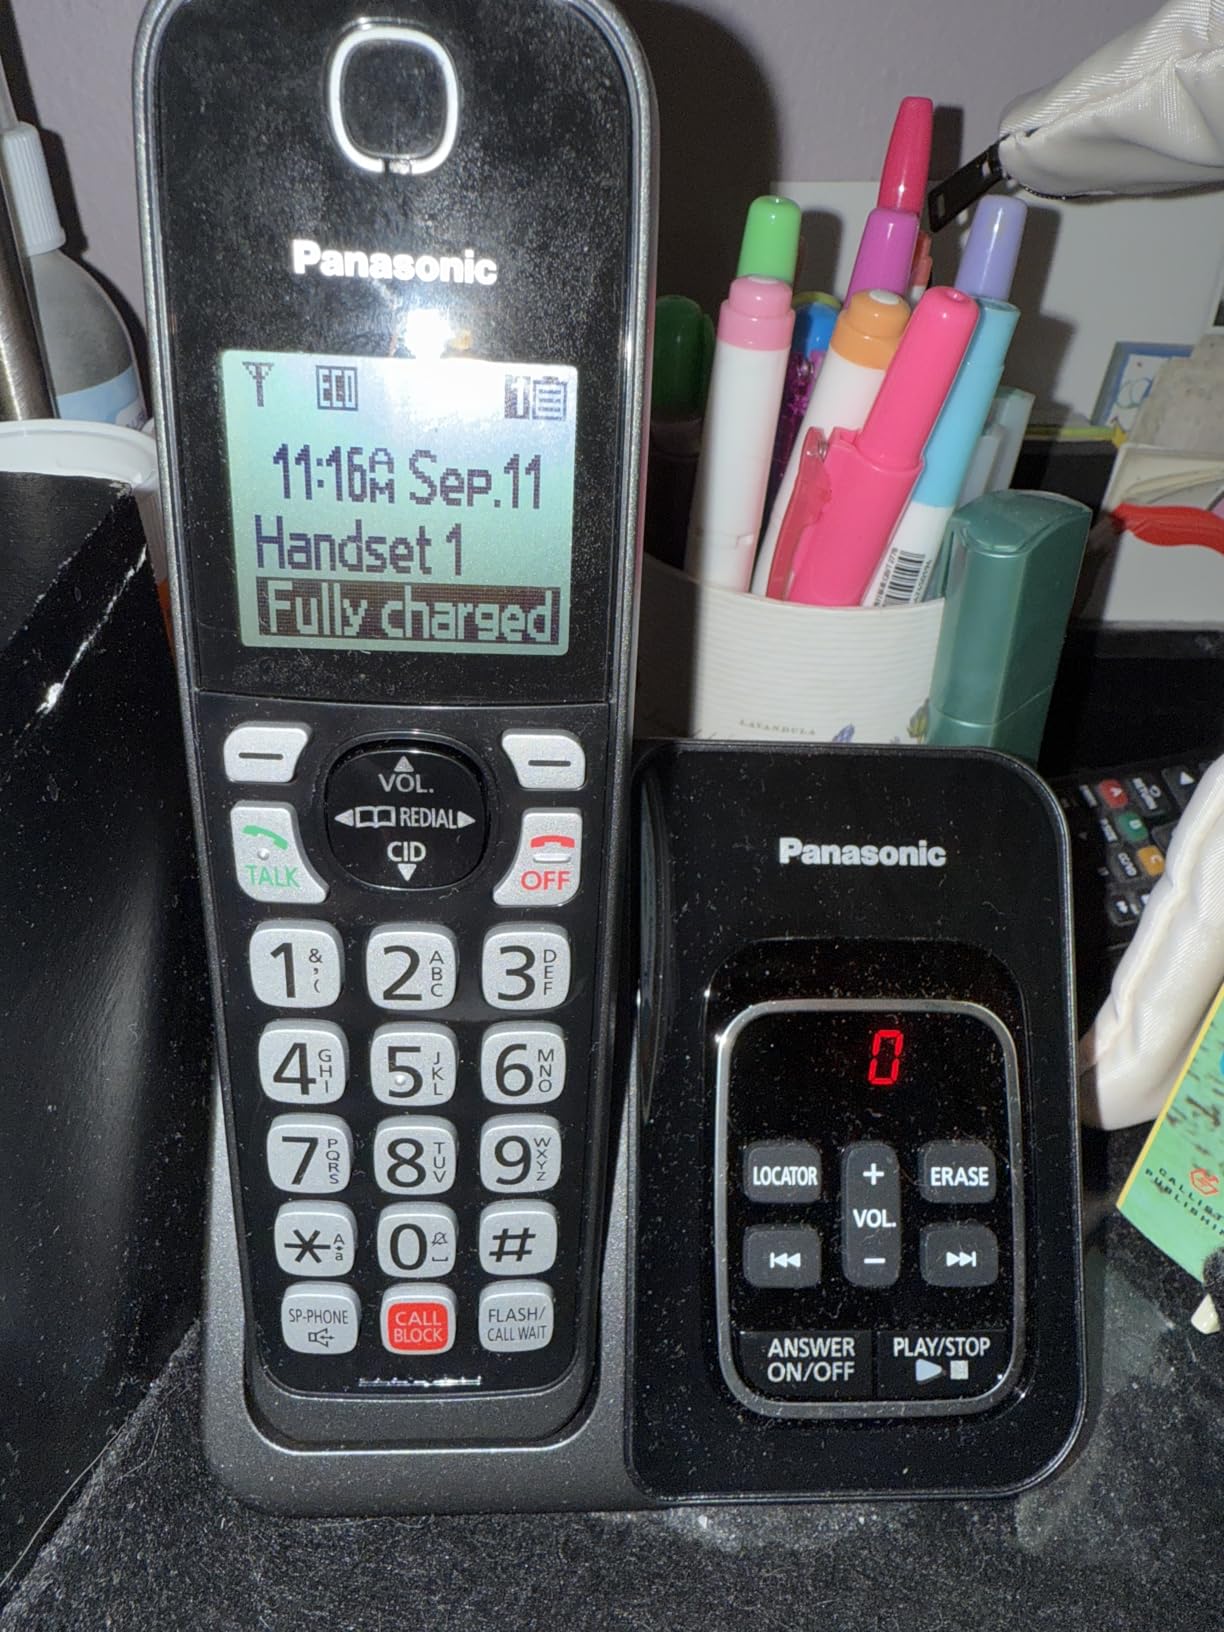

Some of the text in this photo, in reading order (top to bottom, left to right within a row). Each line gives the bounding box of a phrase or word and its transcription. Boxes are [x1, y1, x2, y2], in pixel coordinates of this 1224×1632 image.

[292, 239, 498, 286] Panasonic
[273, 443, 367, 502] 11:16
[254, 514, 462, 576] Handset 1
[267, 580, 553, 642] Fully charged
[739, 719, 816, 736] LAVANDULA
[378, 774, 434, 794] VOL.
[1110, 787, 1123, 797] A
[400, 807, 457, 828] REDIAL
[387, 841, 427, 862] CID
[778, 836, 948, 868] Panasonic
[1151, 854, 1162, 864] C
[245, 864, 298, 888] TALK
[521, 870, 570, 891] OFF
[270, 942, 296, 999] 1
[382, 945, 423, 1001] 2
[497, 945, 536, 1001] 3
[272, 1042, 317, 1096] 4
[868, 1029, 903, 1086] 0
[387, 1046, 423, 1098] 5
[495, 1043, 534, 1097] 6
[281, 1135, 319, 1185] 7
[386, 1137, 426, 1188] 8
[494, 1135, 532, 1185] 9
[753, 1166, 818, 1186] LOCATOR
[930, 1166, 990, 1187] ERASE
[853, 1208, 897, 1228] VOL.
[389, 1223, 428, 1271] 0
[489, 1228, 536, 1263] #
[289, 1307, 349, 1325] SP-PHONE
[395, 1310, 442, 1327] CALL
[488, 1305, 546, 1323] FLASH/
[393, 1327, 443, 1343] BLOCK
[487, 1325, 547, 1342] CALL WAIT
[768, 1337, 855, 1358] ANSWER
[893, 1336, 991, 1358] PLAY/STOP
[767, 1361, 855, 1383] ON/OFF
